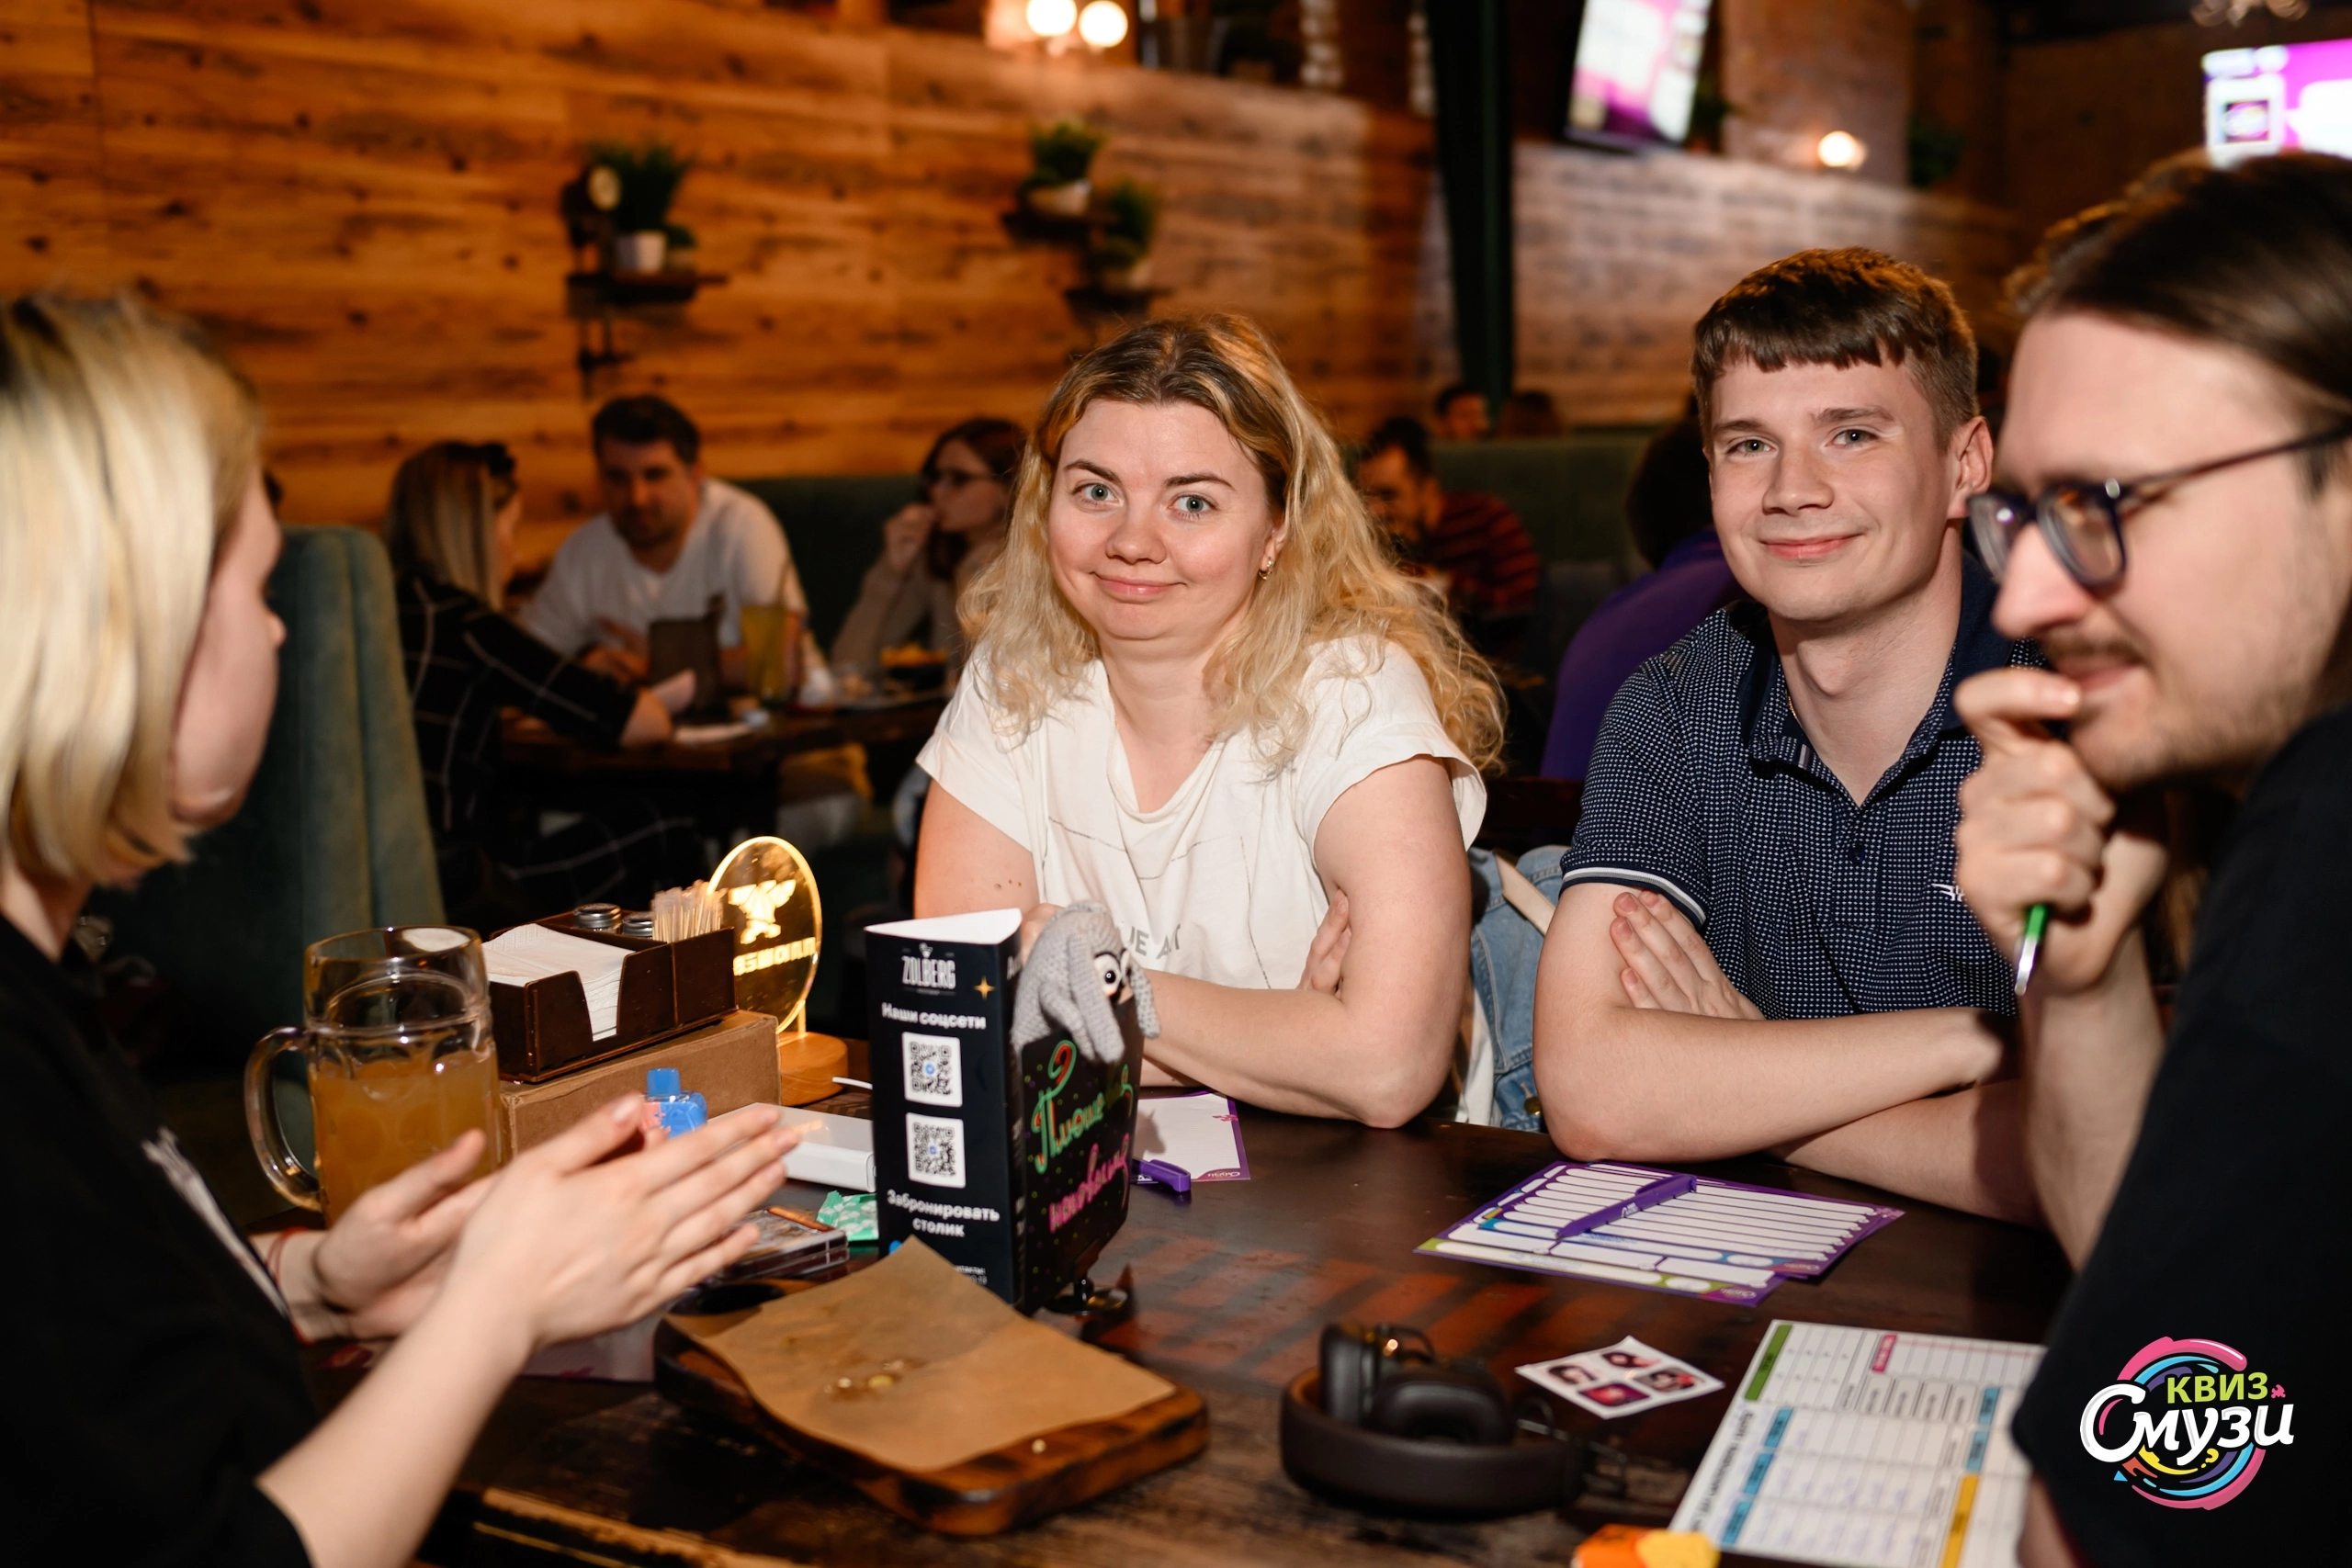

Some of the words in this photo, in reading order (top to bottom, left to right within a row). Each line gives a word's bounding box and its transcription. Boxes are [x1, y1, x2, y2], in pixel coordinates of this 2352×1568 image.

[901, 955, 956, 989] ZOLBERG
[882, 1001, 918, 1023] Наши
[919, 1011, 987, 1029] соцсети
[888, 1189, 1001, 1222] Забронировать
[912, 1217, 966, 1237] столик
